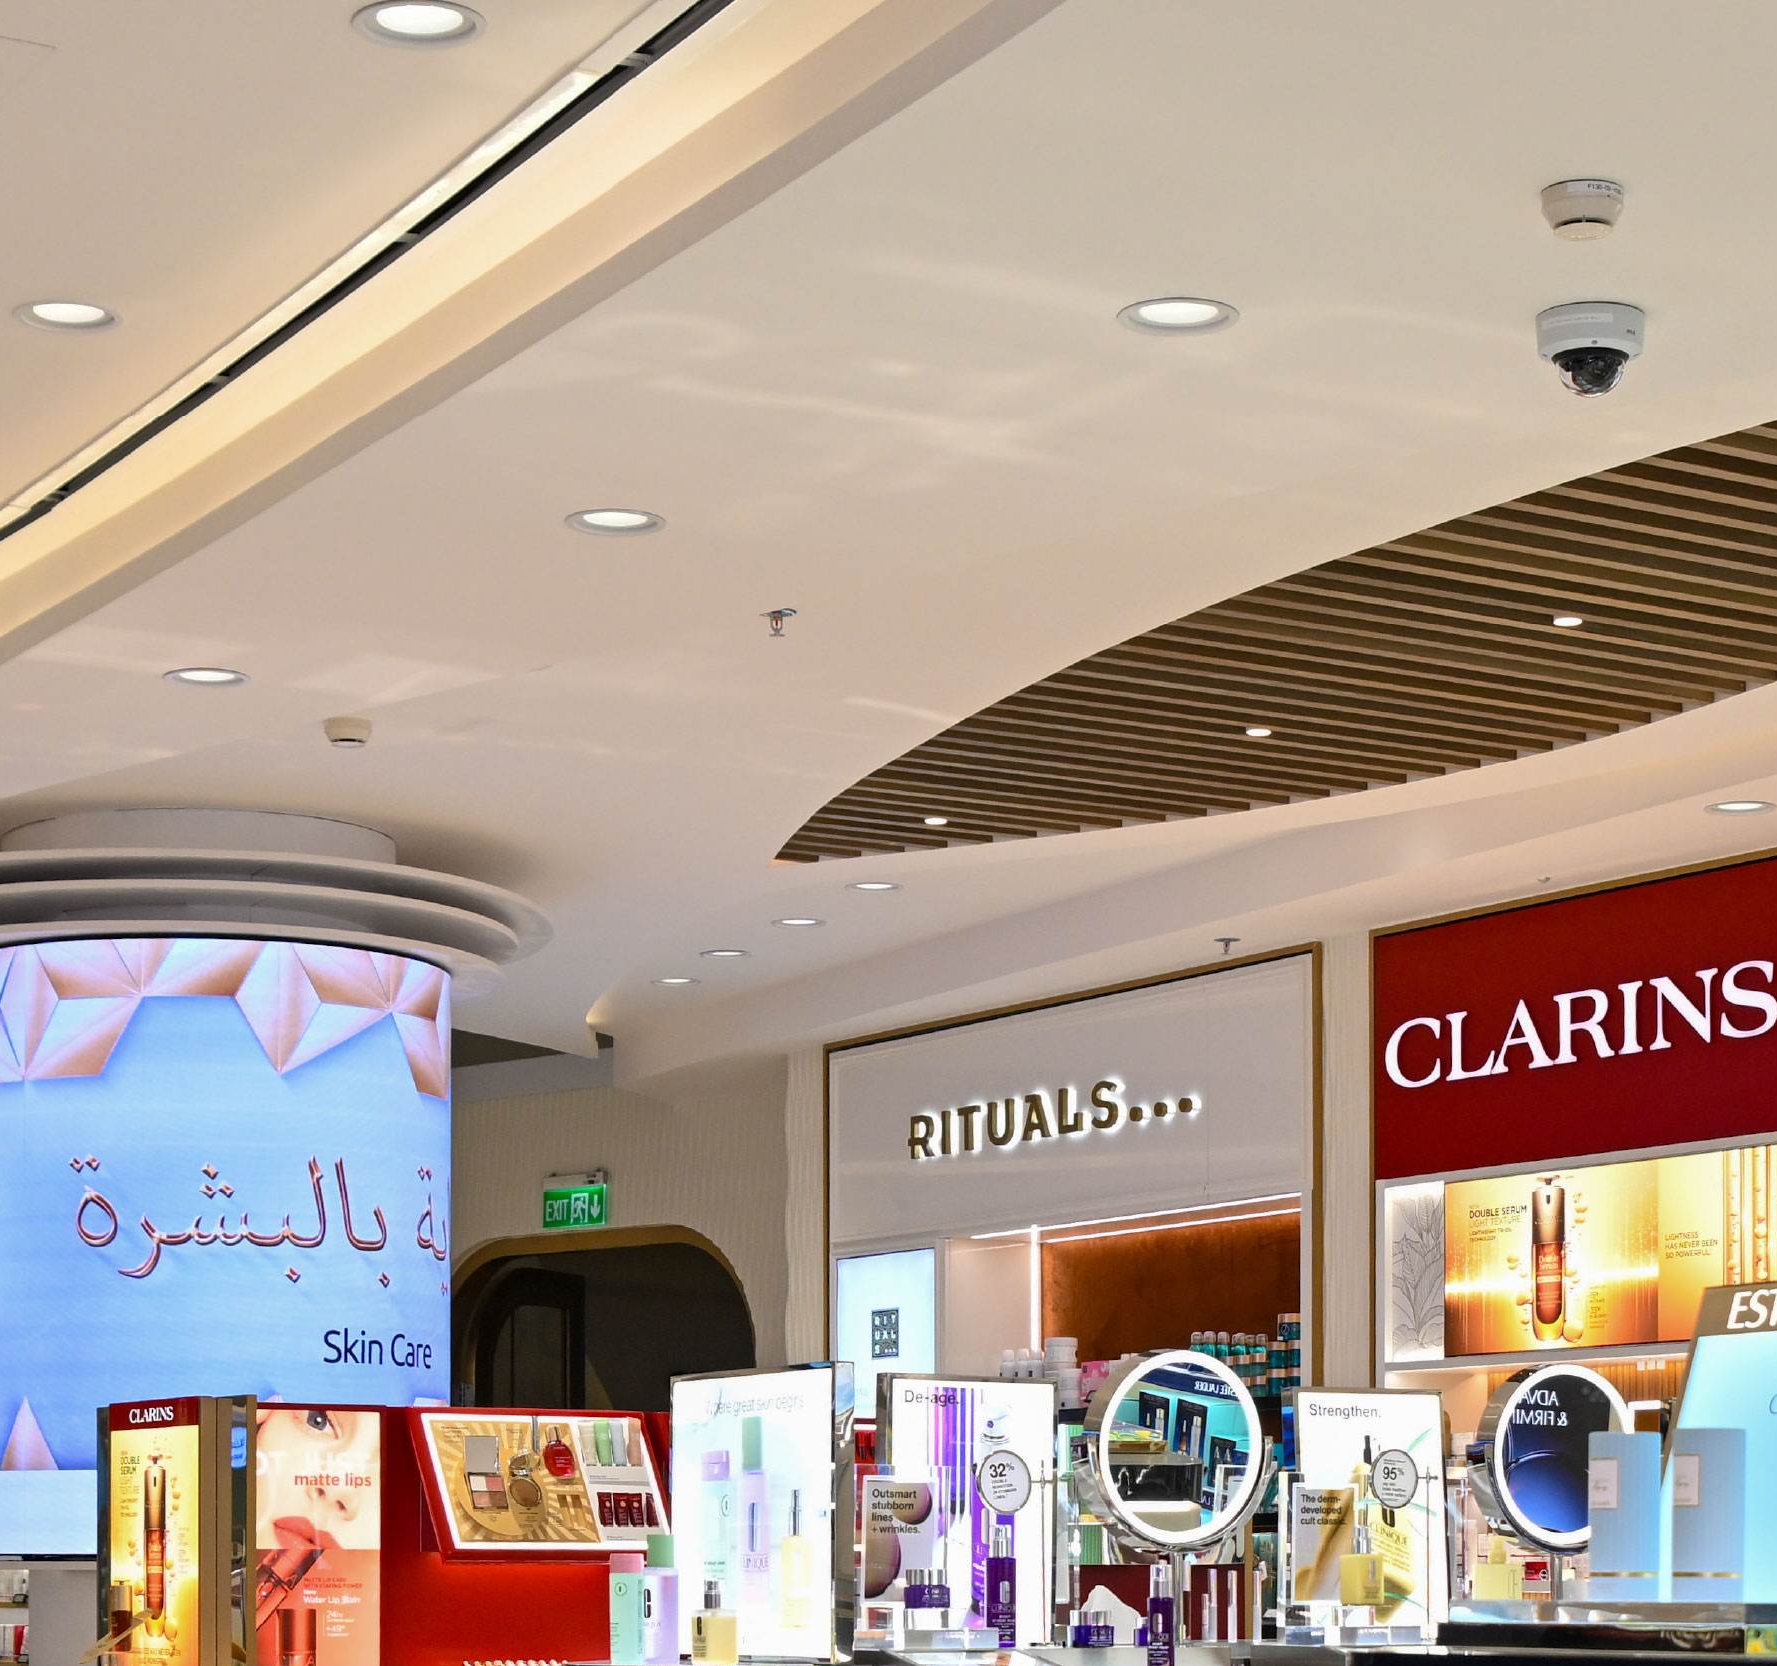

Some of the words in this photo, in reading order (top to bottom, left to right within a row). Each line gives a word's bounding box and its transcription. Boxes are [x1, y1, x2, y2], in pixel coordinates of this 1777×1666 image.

[545, 1199, 569, 1222] EXIT
[1469, 1208, 1501, 1219] DOUBLE
[1502, 1205, 1528, 1215] SERUM
[70, 1154, 389, 1288] بالبشرة
[1469, 1219, 1490, 1228] LIGHT
[1491, 1216, 1522, 1226] TEXTURE
[1665, 1231, 1699, 1241] LIGHTNESS
[1665, 1241, 1679, 1249] HAS
[1680, 1240, 1701, 1249] NEVER
[1702, 1238, 1719, 1247] BEEN
[1665, 1251, 1674, 1259] SO
[323, 1329, 383, 1365] Skin
[390, 1333, 432, 1368] Care
[904, 1390, 960, 1407] De-age.
[129, 1406, 174, 1423] CLARINS
[1309, 1404, 1382, 1419] Strengthen.
[121, 1456, 140, 1465] DOUBLE
[121, 1466, 137, 1475] SERUM
[989, 1463, 1015, 1478] 32%
[1382, 1466, 1405, 1480] 95%
[294, 1472, 340, 1487] matte
[345, 1472, 372, 1489] lips
[872, 1489, 917, 1499] Outsmart
[1301, 1494, 1316, 1503] The
[1317, 1494, 1341, 1503] derm-
[872, 1501, 914, 1511] stubborn
[1300, 1505, 1342, 1515] developed
[872, 1512, 894, 1522] lines
[1300, 1516, 1316, 1525] cult
[1317, 1516, 1347, 1525] classic.
[879, 1524, 921, 1534] wrinkles.
[303, 1596, 326, 1604] Water
[327, 1596, 340, 1605] Lip
